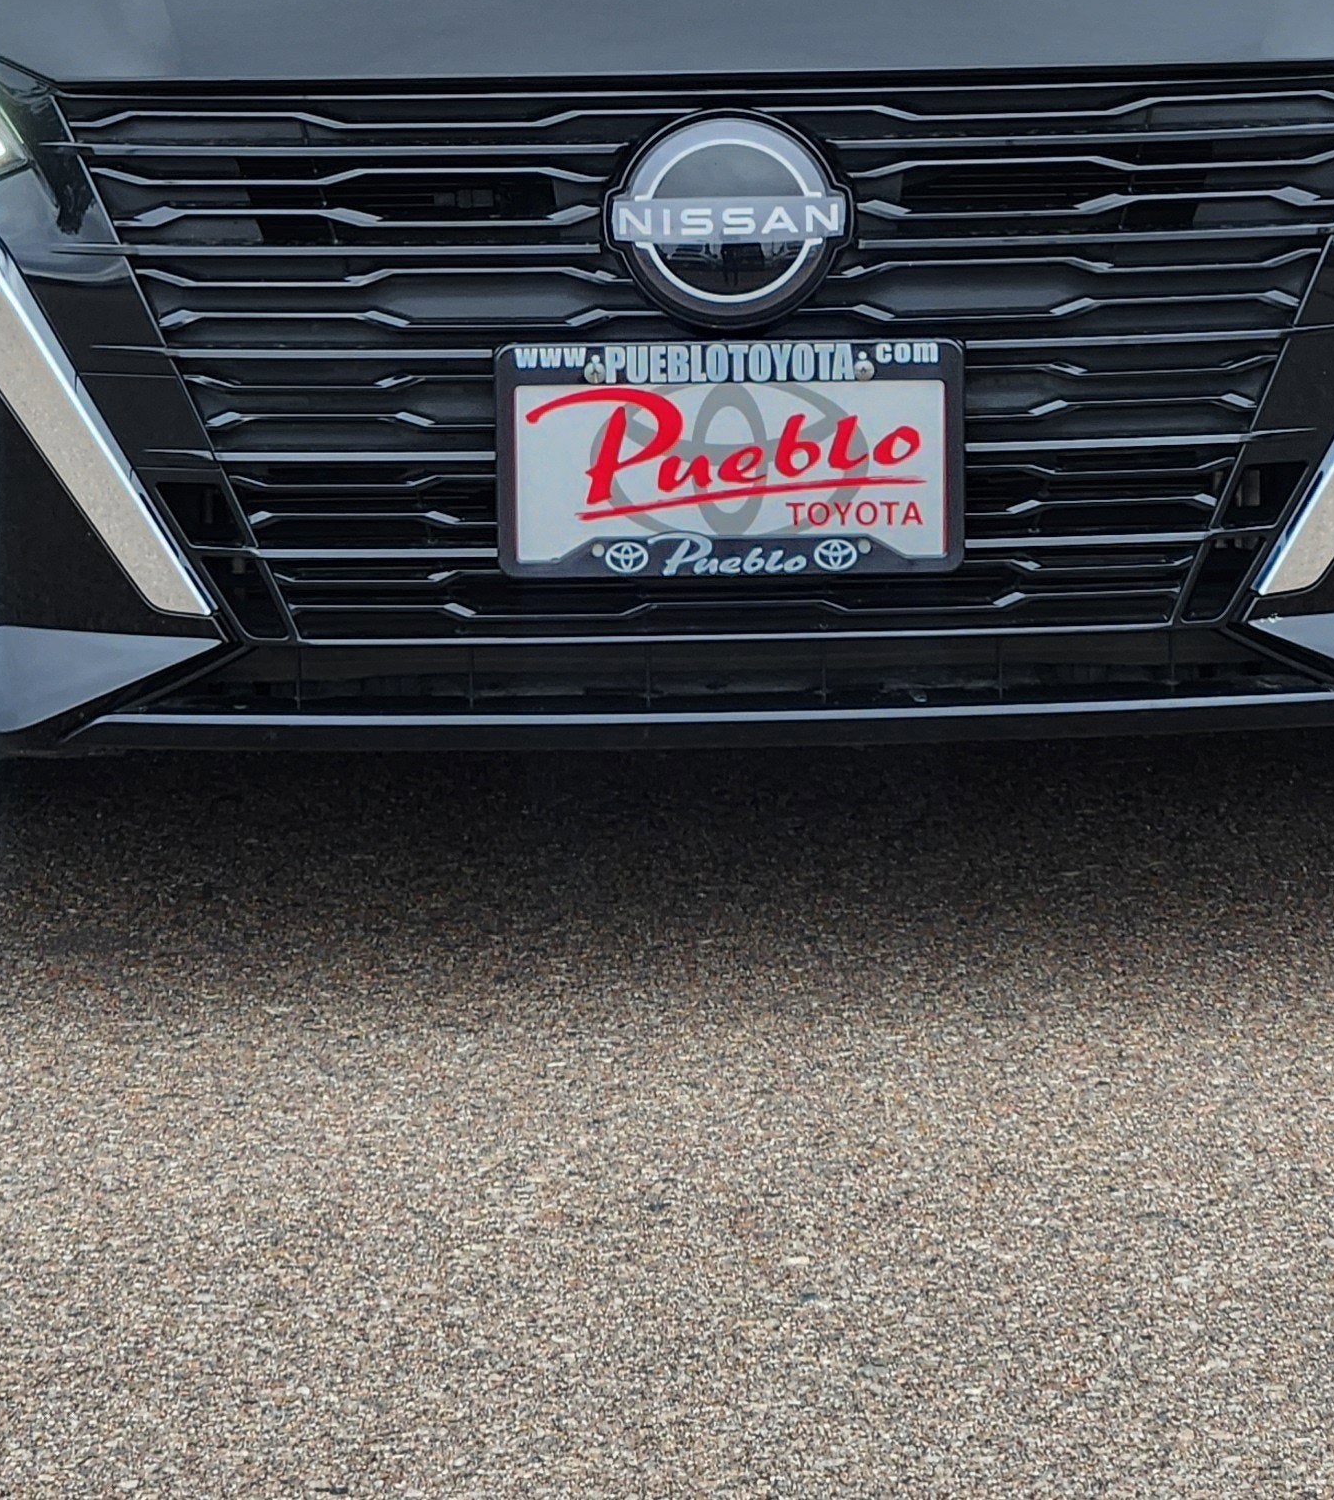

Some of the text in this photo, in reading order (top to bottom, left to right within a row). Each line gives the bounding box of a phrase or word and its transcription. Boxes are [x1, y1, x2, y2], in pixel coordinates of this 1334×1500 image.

[619, 204, 840, 235] NISSAN
[526, 388, 921, 503] Pueblo
[787, 501, 923, 526] TOYOTA
[648, 531, 808, 576] Pueblo
